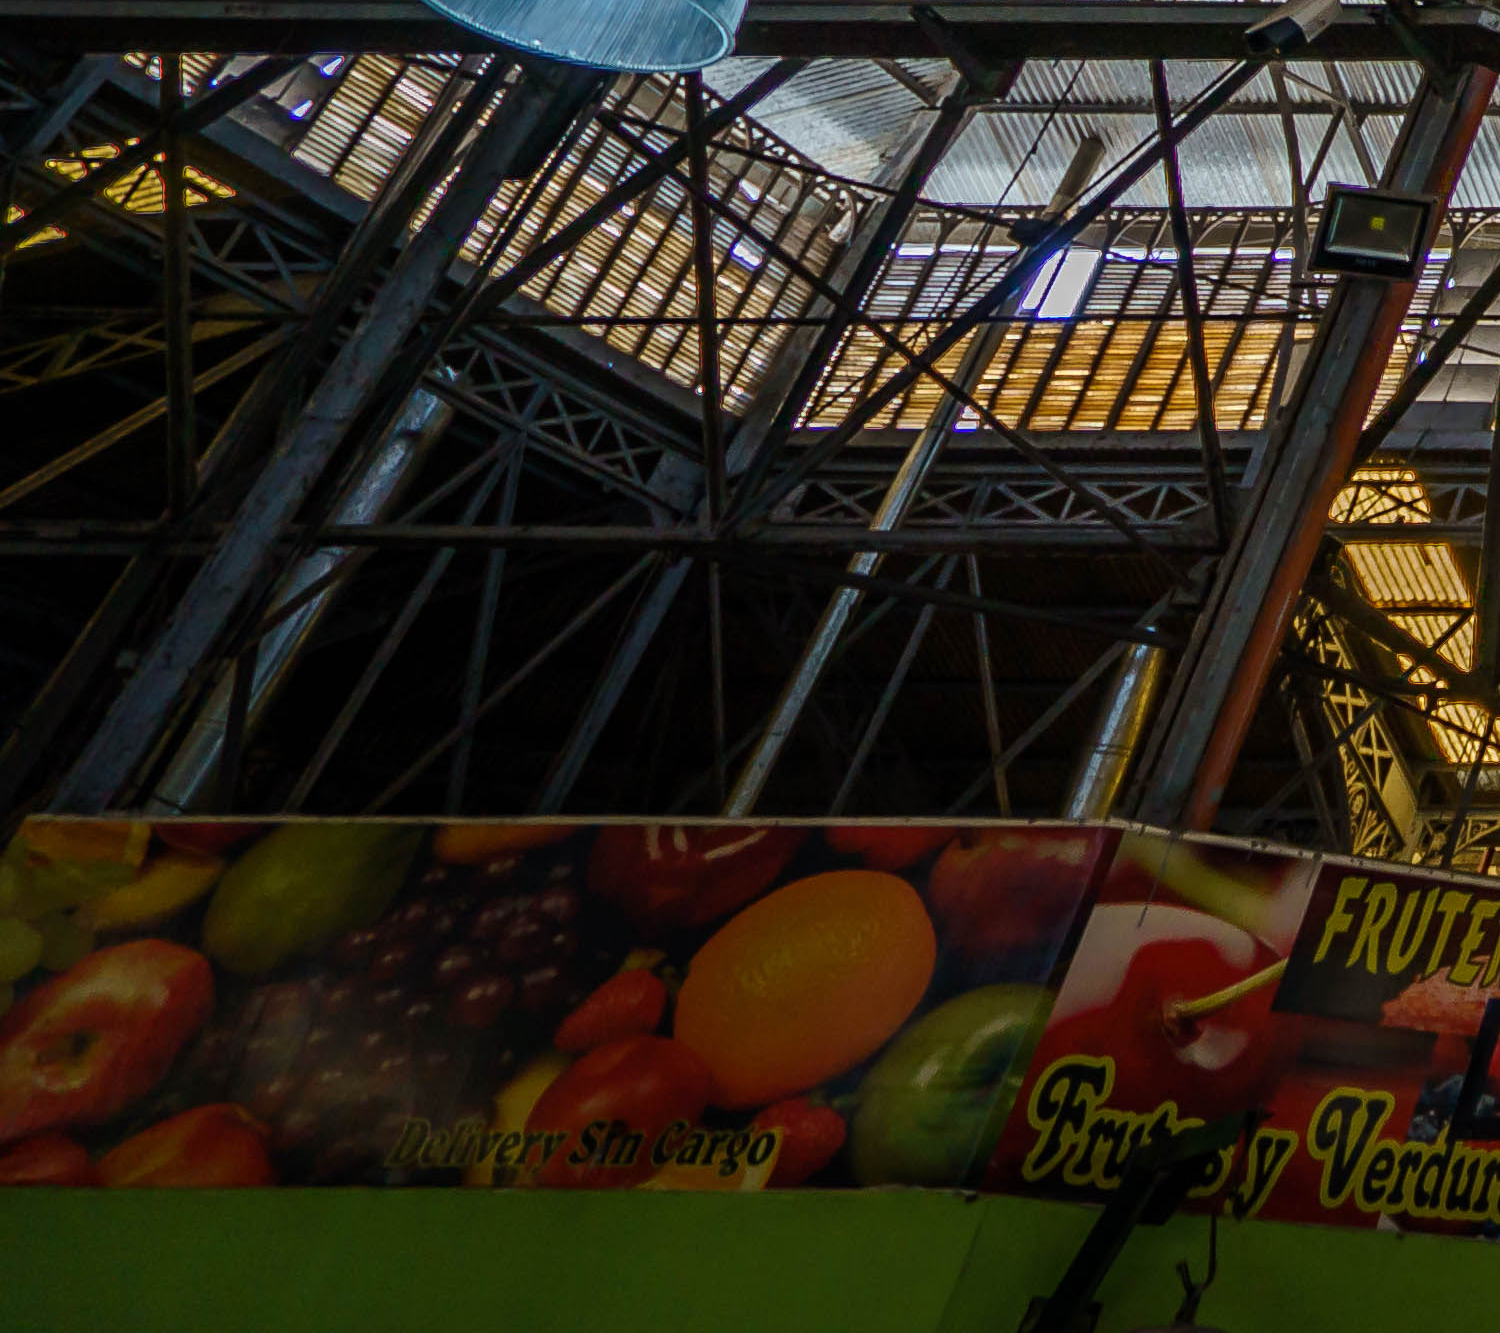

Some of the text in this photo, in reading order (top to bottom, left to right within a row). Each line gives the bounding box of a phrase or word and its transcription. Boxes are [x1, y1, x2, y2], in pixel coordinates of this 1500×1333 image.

[383, 1116, 777, 1177] Delivery Sin Cargo
